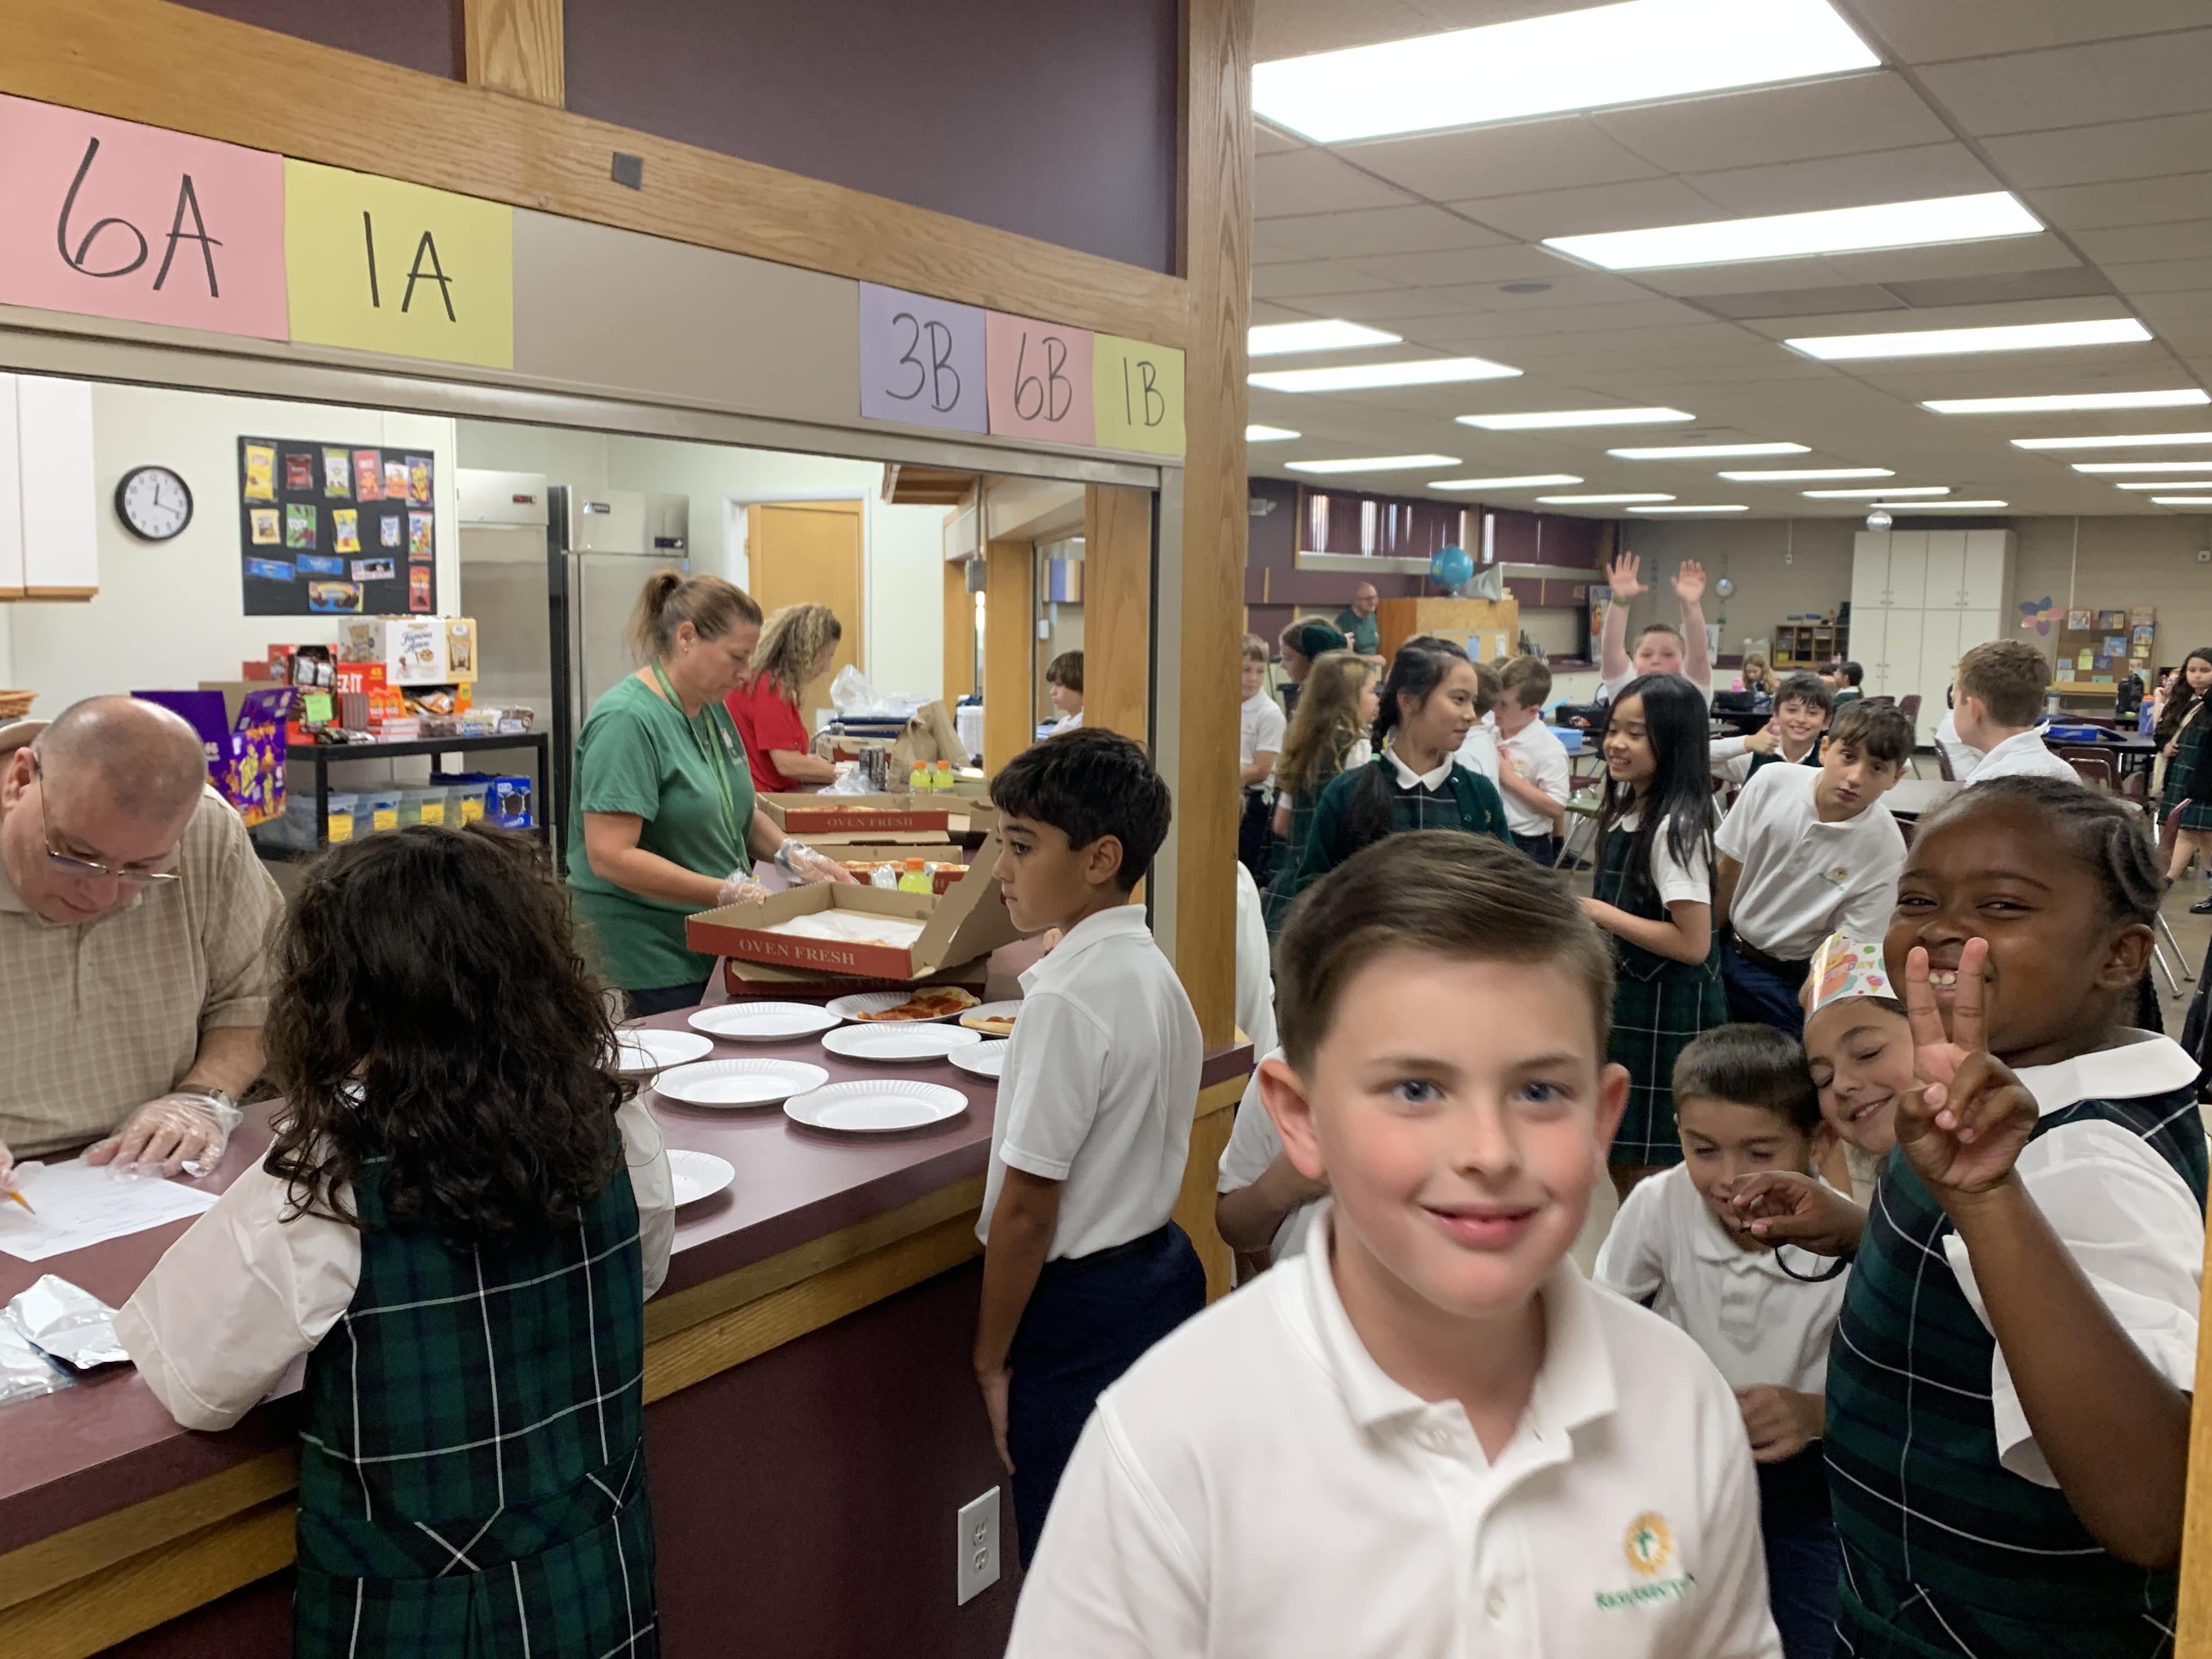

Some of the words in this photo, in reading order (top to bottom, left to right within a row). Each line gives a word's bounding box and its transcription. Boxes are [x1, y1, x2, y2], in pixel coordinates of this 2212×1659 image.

[58, 137, 223, 298] 6A
[363, 211, 456, 323] 1A
[885, 312, 961, 413] 3B
[1014, 332, 1073, 422] 6B
[1123, 357, 1165, 426] 1B
[827, 818, 865, 827] OVEN
[870, 818, 913, 827] FRESH
[740, 939, 788, 957] OVEN
[795, 946, 855, 966] FRESH
